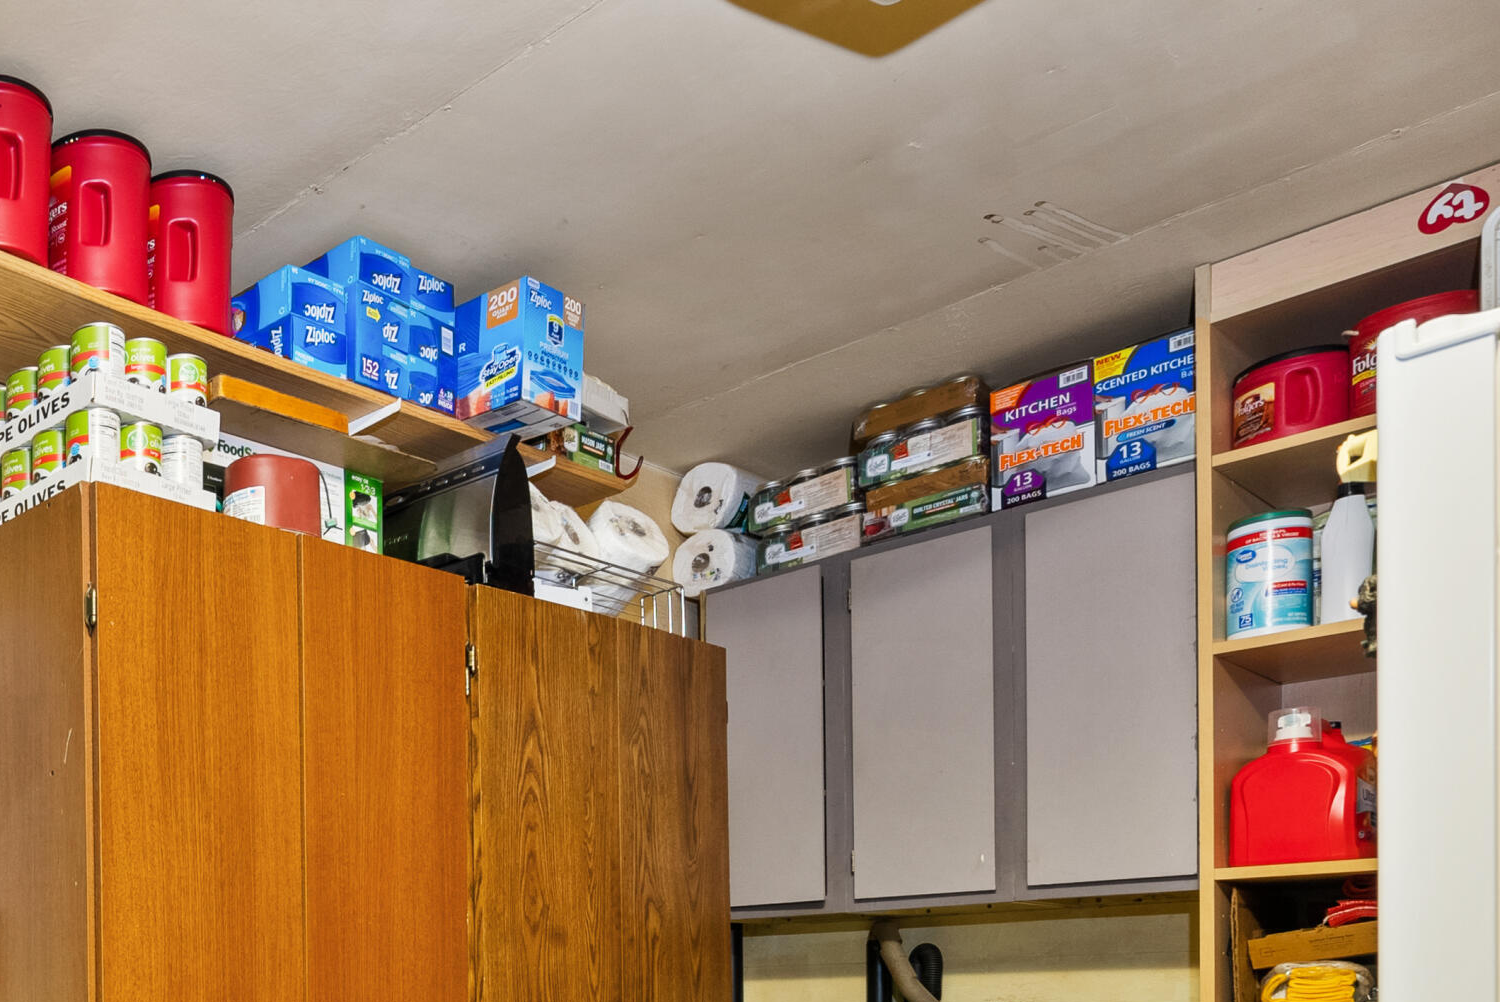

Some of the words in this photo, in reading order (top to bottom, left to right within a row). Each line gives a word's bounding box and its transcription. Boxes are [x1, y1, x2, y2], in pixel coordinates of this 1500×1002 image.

[371, 272, 401, 295] Ziploc
[418, 274, 445, 293] Ziploc
[362, 289, 384, 305] Ziploc
[488, 286, 518, 312] 200
[529, 290, 552, 310] Ziploc
[564, 296, 582, 315] 200
[304, 303, 335, 324] Ziploc
[305, 325, 337, 346] Ziploc
[382, 322, 399, 343] Zip
[362, 356, 379, 377] 152
[1096, 353, 1122, 367] NEW
[1352, 353, 1378, 376] Folg
[1096, 369, 1148, 394] SCENTED
[1151, 354, 1195, 376] KITCHE
[17, 391, 70, 434] OLIVES
[1005, 392, 1071, 422] KITCHEN
[1056, 405, 1077, 417] Bags
[1104, 396, 1196, 439] FLEX-TECH
[217, 439, 258, 458] FoodS
[999, 433, 1084, 472] FLEX-TECH
[1120, 441, 1142, 459] 13
[1013, 471, 1033, 487] 13
[1112, 467, 1127, 478] 200
[1128, 461, 1151, 473] BAGS
[1006, 495, 1020, 505] 200
[1021, 489, 1042, 501] BAGS
